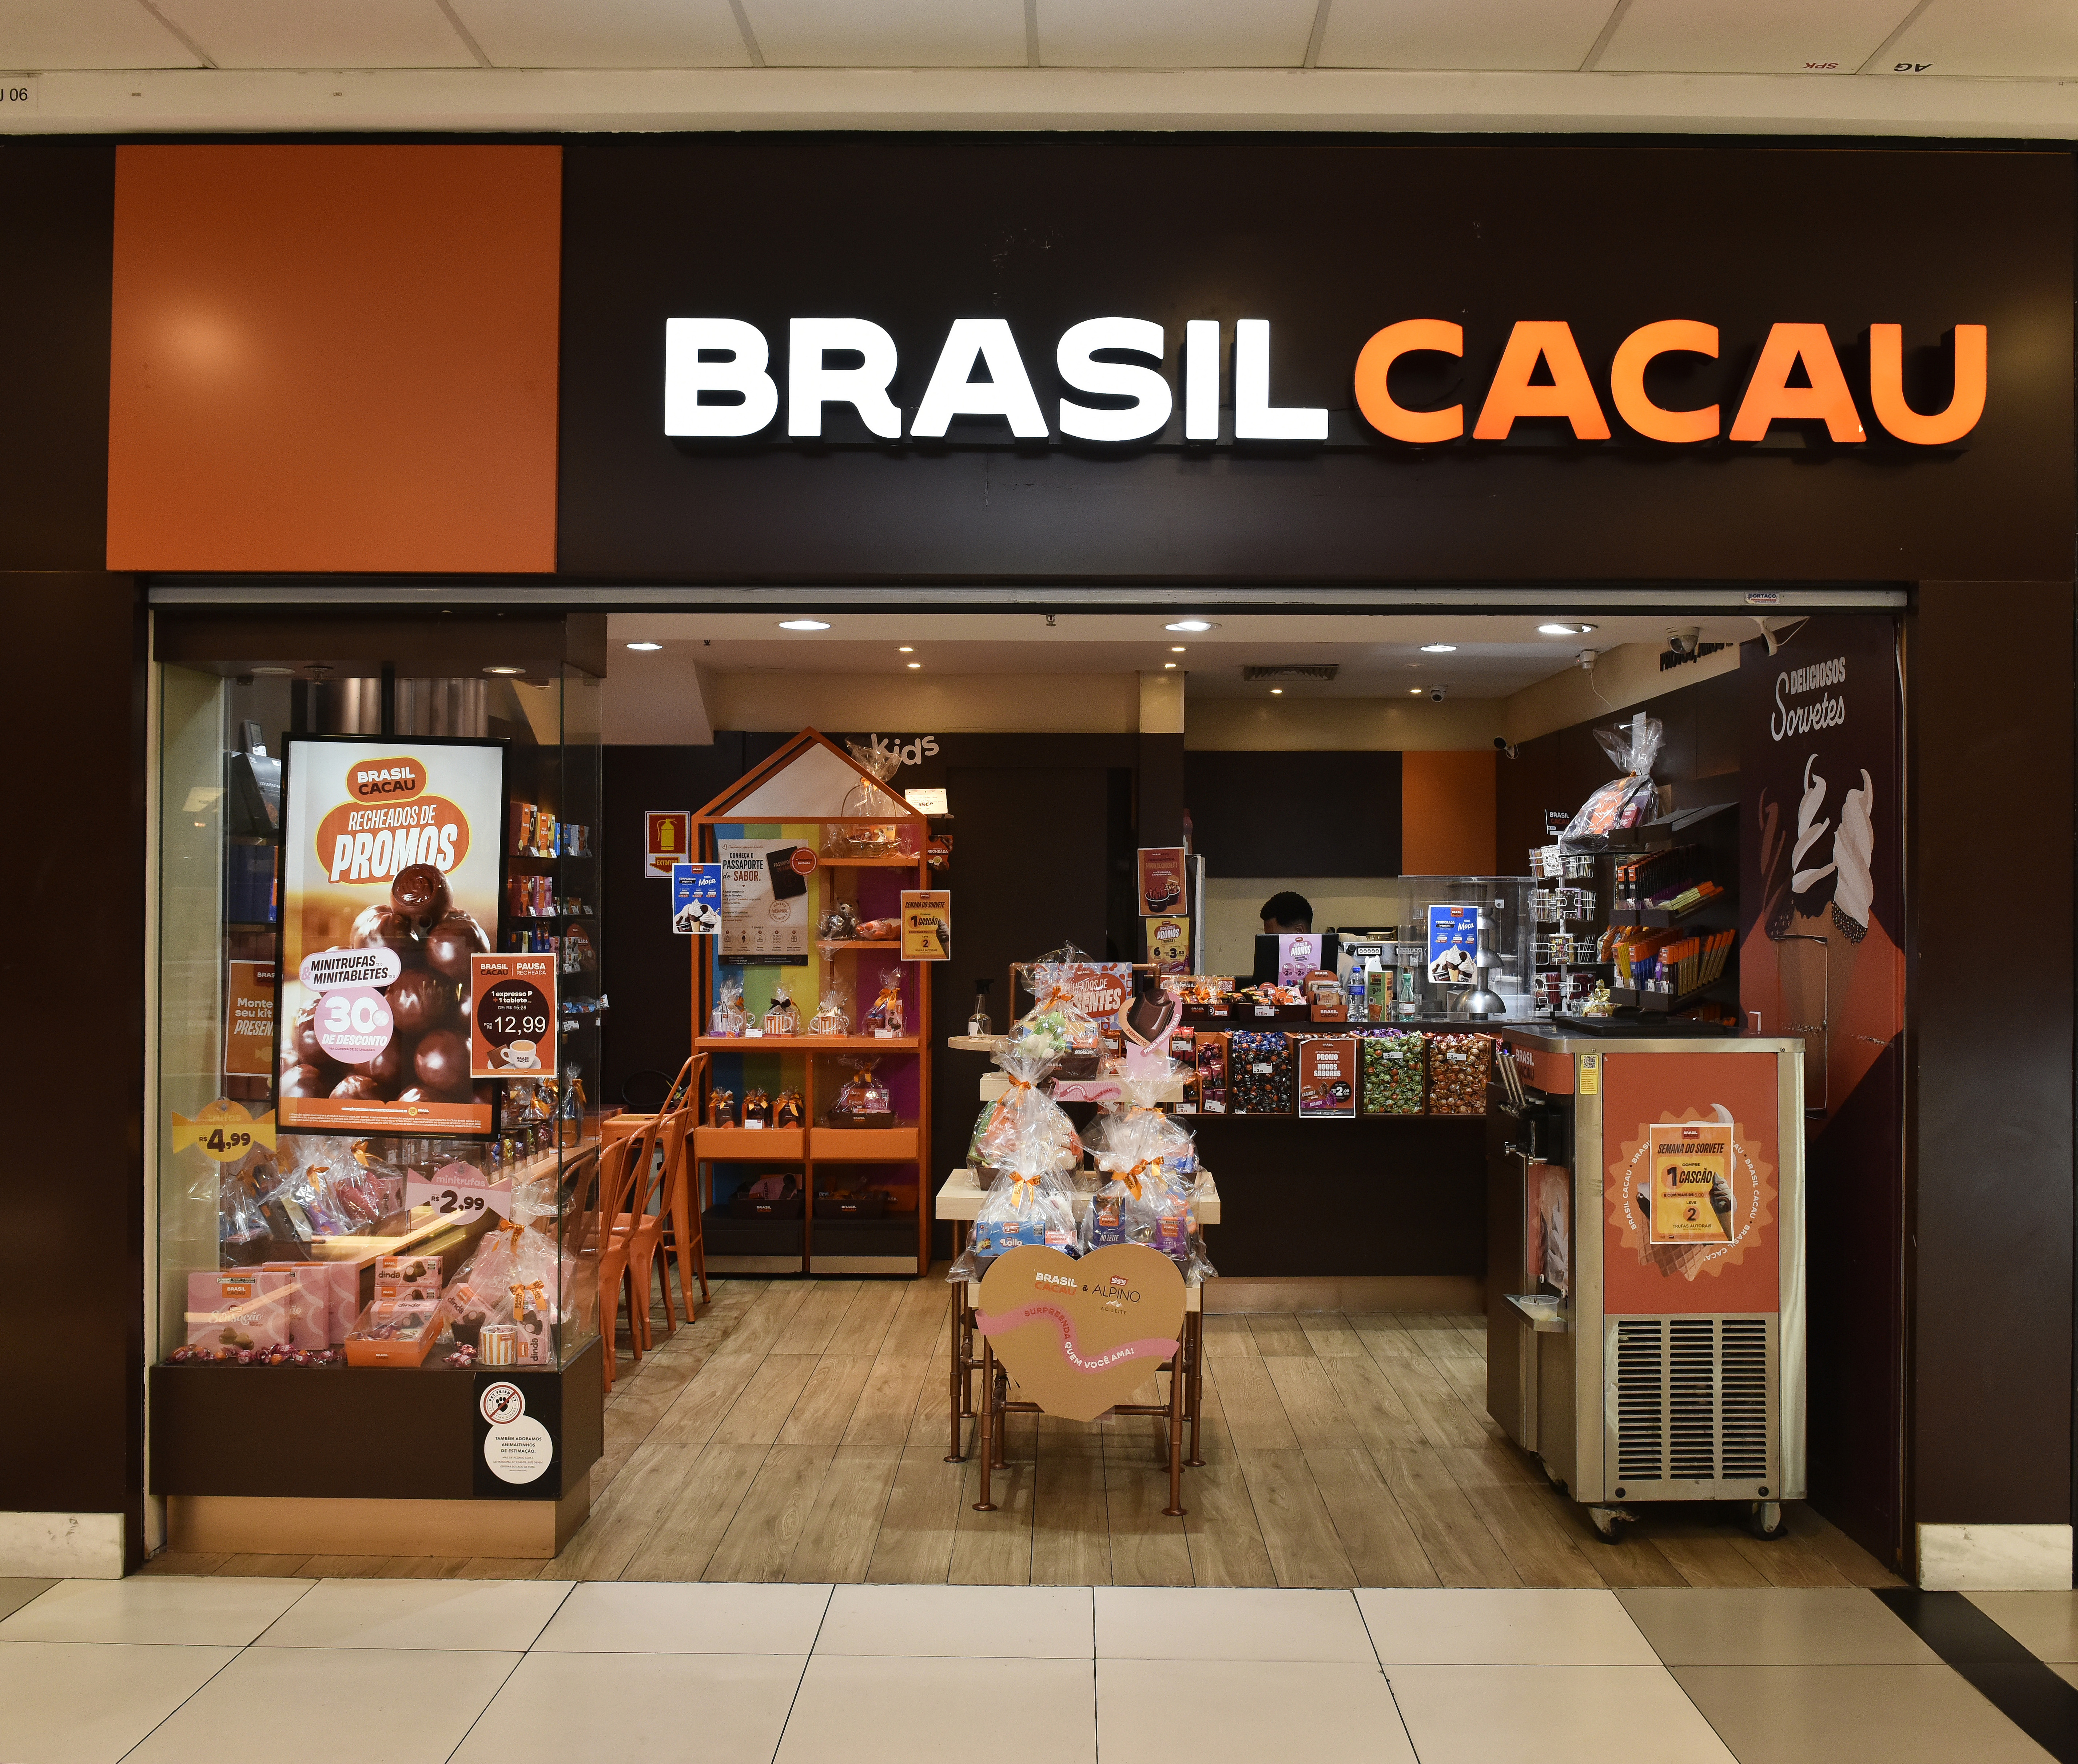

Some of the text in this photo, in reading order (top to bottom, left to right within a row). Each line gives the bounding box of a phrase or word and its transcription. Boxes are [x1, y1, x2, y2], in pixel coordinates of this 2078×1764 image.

[9, 88, 28, 101] 06
[665, 316, 1987, 445] BRASIL CACAU
[1791, 657, 1846, 695] DELICIOSOS
[1771, 672, 1845, 741] Sorvetes
[357, 767, 415, 783] BRASIL
[358, 779, 415, 795] CACAU
[348, 804, 437, 831] RECHEADOS DE
[330, 823, 458, 881] PROMOS
[723, 859, 764, 870] PASSAPORTE
[698, 878, 716, 886] Moça
[733, 870, 761, 881] SABOR.
[911, 915, 938, 927] 1 CASCÃO
[1457, 922, 1474, 931] Moça
[1157, 928, 1179, 940] PROMOS
[923, 939, 928, 947] 2
[1291, 945, 1311, 956] PROMOS
[1154, 947, 1161, 956] 6
[311, 955, 377, 972] MINITRUFAS
[313, 967, 389, 985] MINITABLETES
[237, 998, 273, 1008] Monte
[235, 1008, 272, 1018] seu kit
[234, 1020, 274, 1036] PRESEN
[494, 1016, 546, 1036] 12,99
[1143, 1014, 1181, 1054] PARA PRESENTEAR
[322, 1034, 387, 1046] DE DESCONTO
[1126, 1028, 1147, 1046] PERFEITO
[1516, 1049, 1534, 1066] BRASIL
[1336, 1086, 1350, 1096] 2,09
[207, 1129, 251, 1152] 4,99
[1657, 1143, 1684, 1154] SEMANA
[1685, 1143, 1694, 1153] DO
[1695, 1143, 1725, 1153] SORVETE
[437, 1175, 485, 1187] minitrufas
[1667, 1167, 1712, 1186] 1 CASCÃO
[1744, 1158, 1760, 1220] BRASIL CACAU
[440, 1190, 484, 1213] 2,99
[1622, 1169, 1637, 1231] BRASIL CACAU
[1687, 1208, 1696, 1221] 2
[1704, 1224, 1751, 1262] BRASIL CACA
[1036, 1272, 1077, 1288] BRASIL
[1035, 1281, 1076, 1296] CACAU
[1092, 1284, 1140, 1303] ALPINO
[1024, 1307, 1135, 1368] SURPREENDA QUEM VOCÊ AMA!
[530, 1338, 538, 1361] dinda
[496, 1390, 517, 1402] FRIENLY
